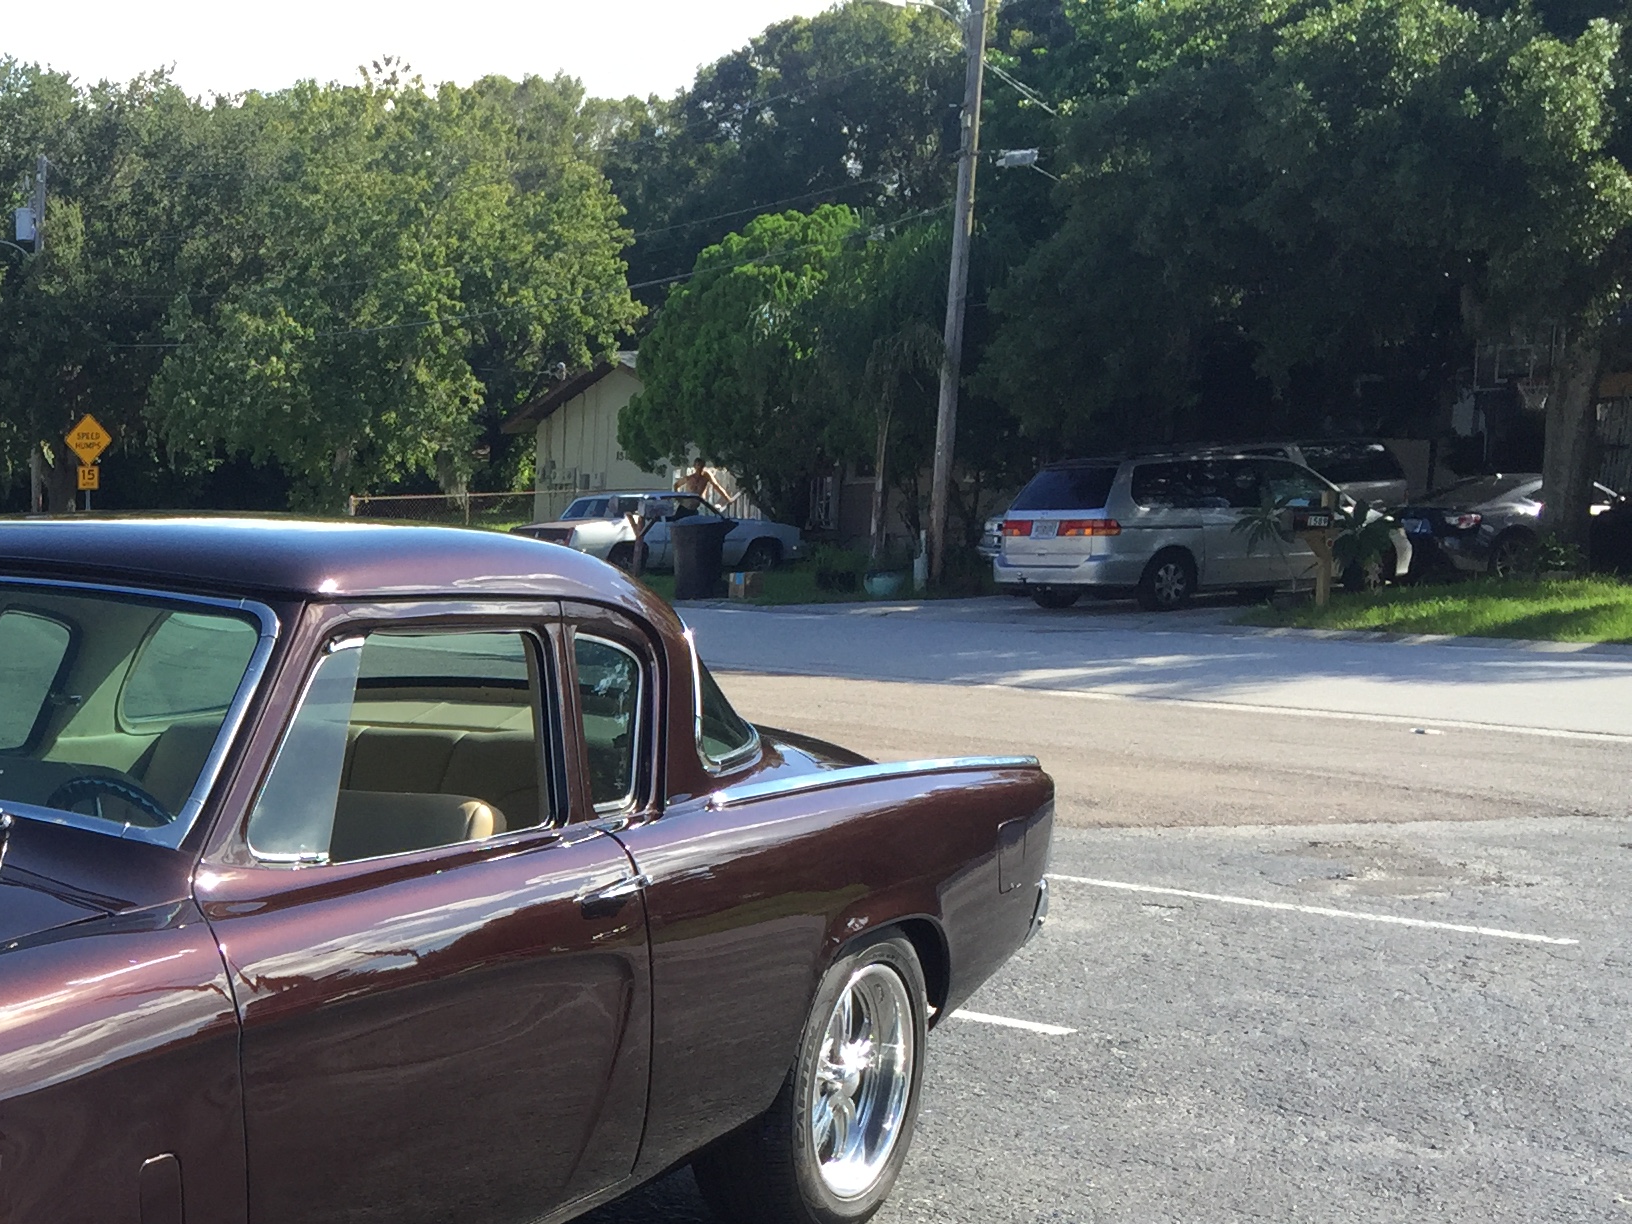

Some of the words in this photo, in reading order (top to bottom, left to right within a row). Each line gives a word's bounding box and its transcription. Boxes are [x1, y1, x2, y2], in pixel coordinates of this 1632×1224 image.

[76, 431, 101, 441] SPEED
[75, 441, 102, 450] HUMPS
[81, 469, 96, 481] 15
[1308, 516, 1328, 526] 1589
